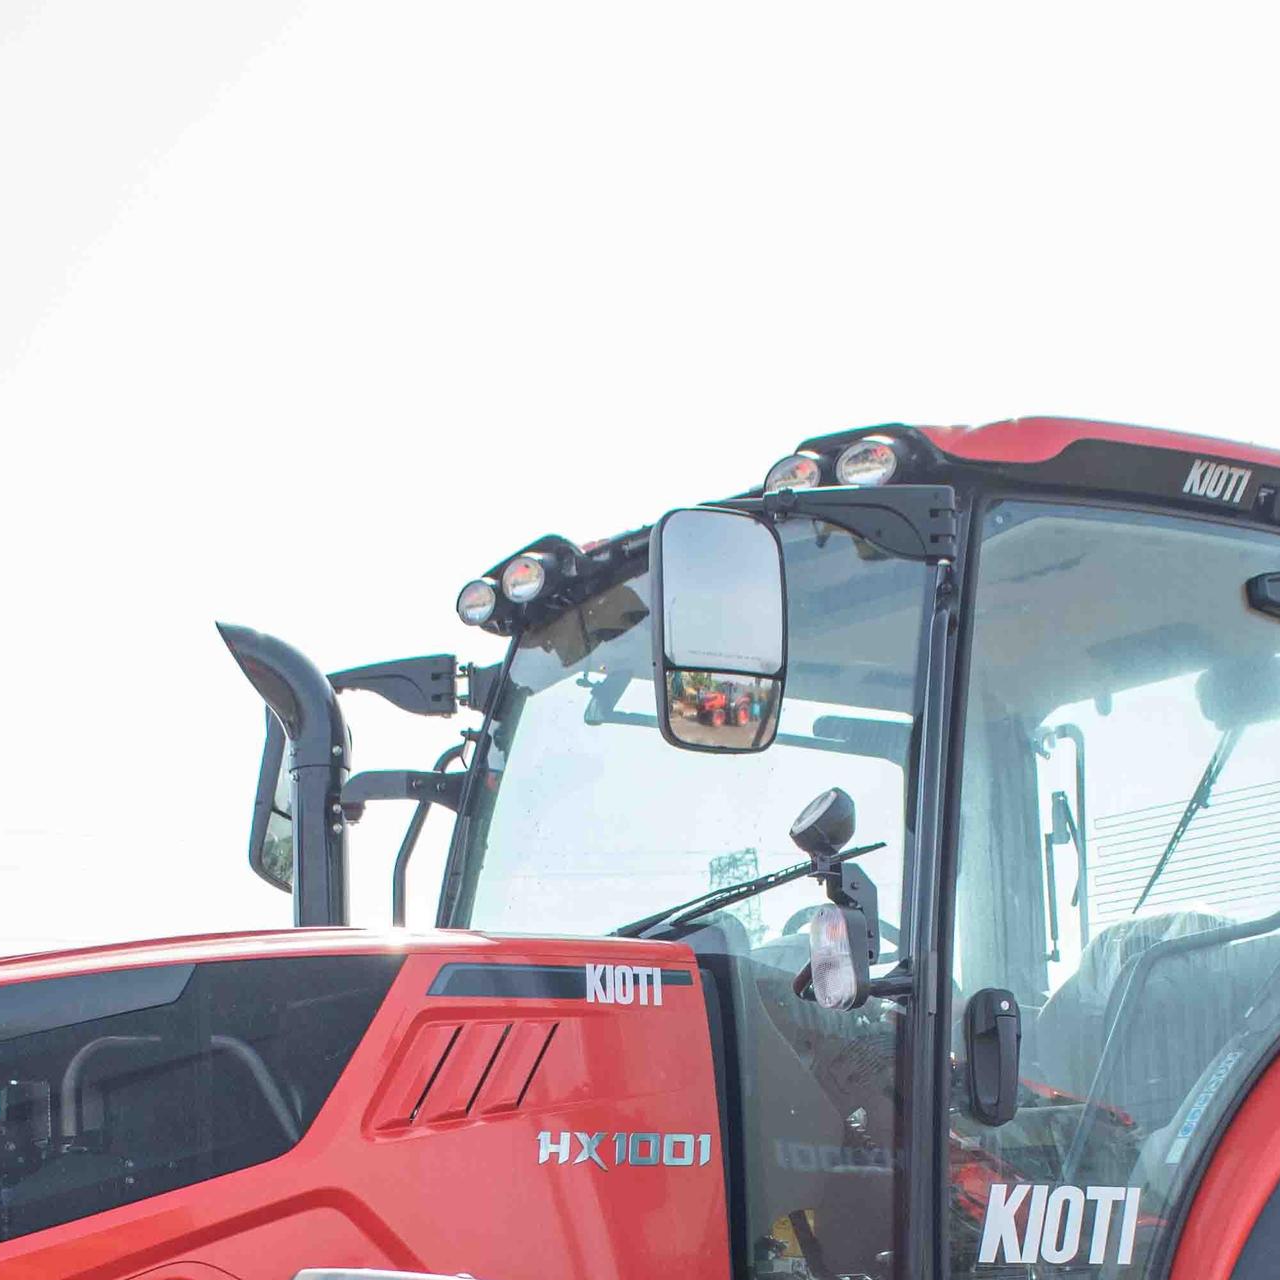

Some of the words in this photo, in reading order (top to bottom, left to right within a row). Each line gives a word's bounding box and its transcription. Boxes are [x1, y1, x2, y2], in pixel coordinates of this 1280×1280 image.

[1182, 459, 1252, 504] KIOTI
[585, 963, 663, 1006] KIOTI
[536, 1130, 711, 1172] HX1001
[978, 1184, 1141, 1265] KIOTI
